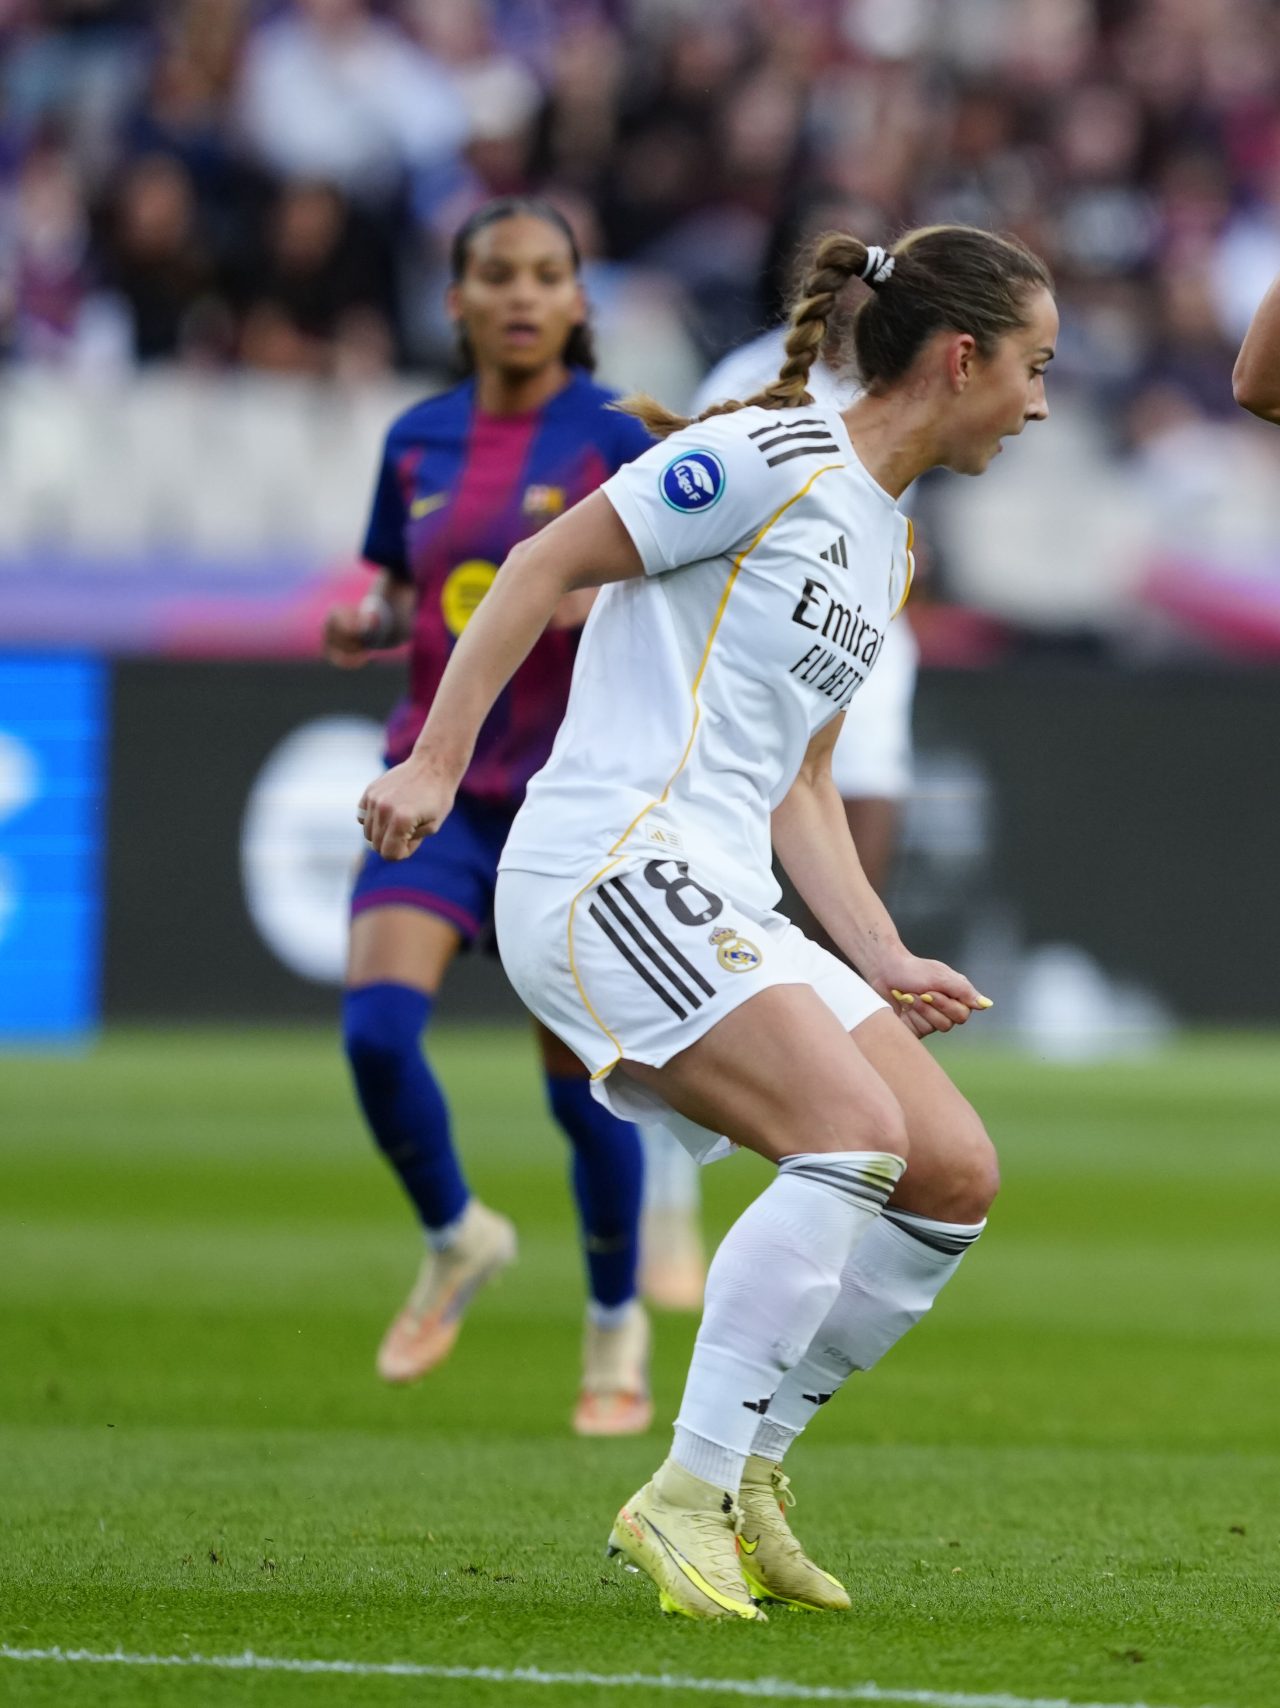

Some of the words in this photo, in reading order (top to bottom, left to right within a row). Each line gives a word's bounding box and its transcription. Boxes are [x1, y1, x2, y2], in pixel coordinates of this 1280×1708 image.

[792, 577, 884, 670] Emira
[789, 644, 837, 684] FLY
[643, 859, 723, 926] 8
